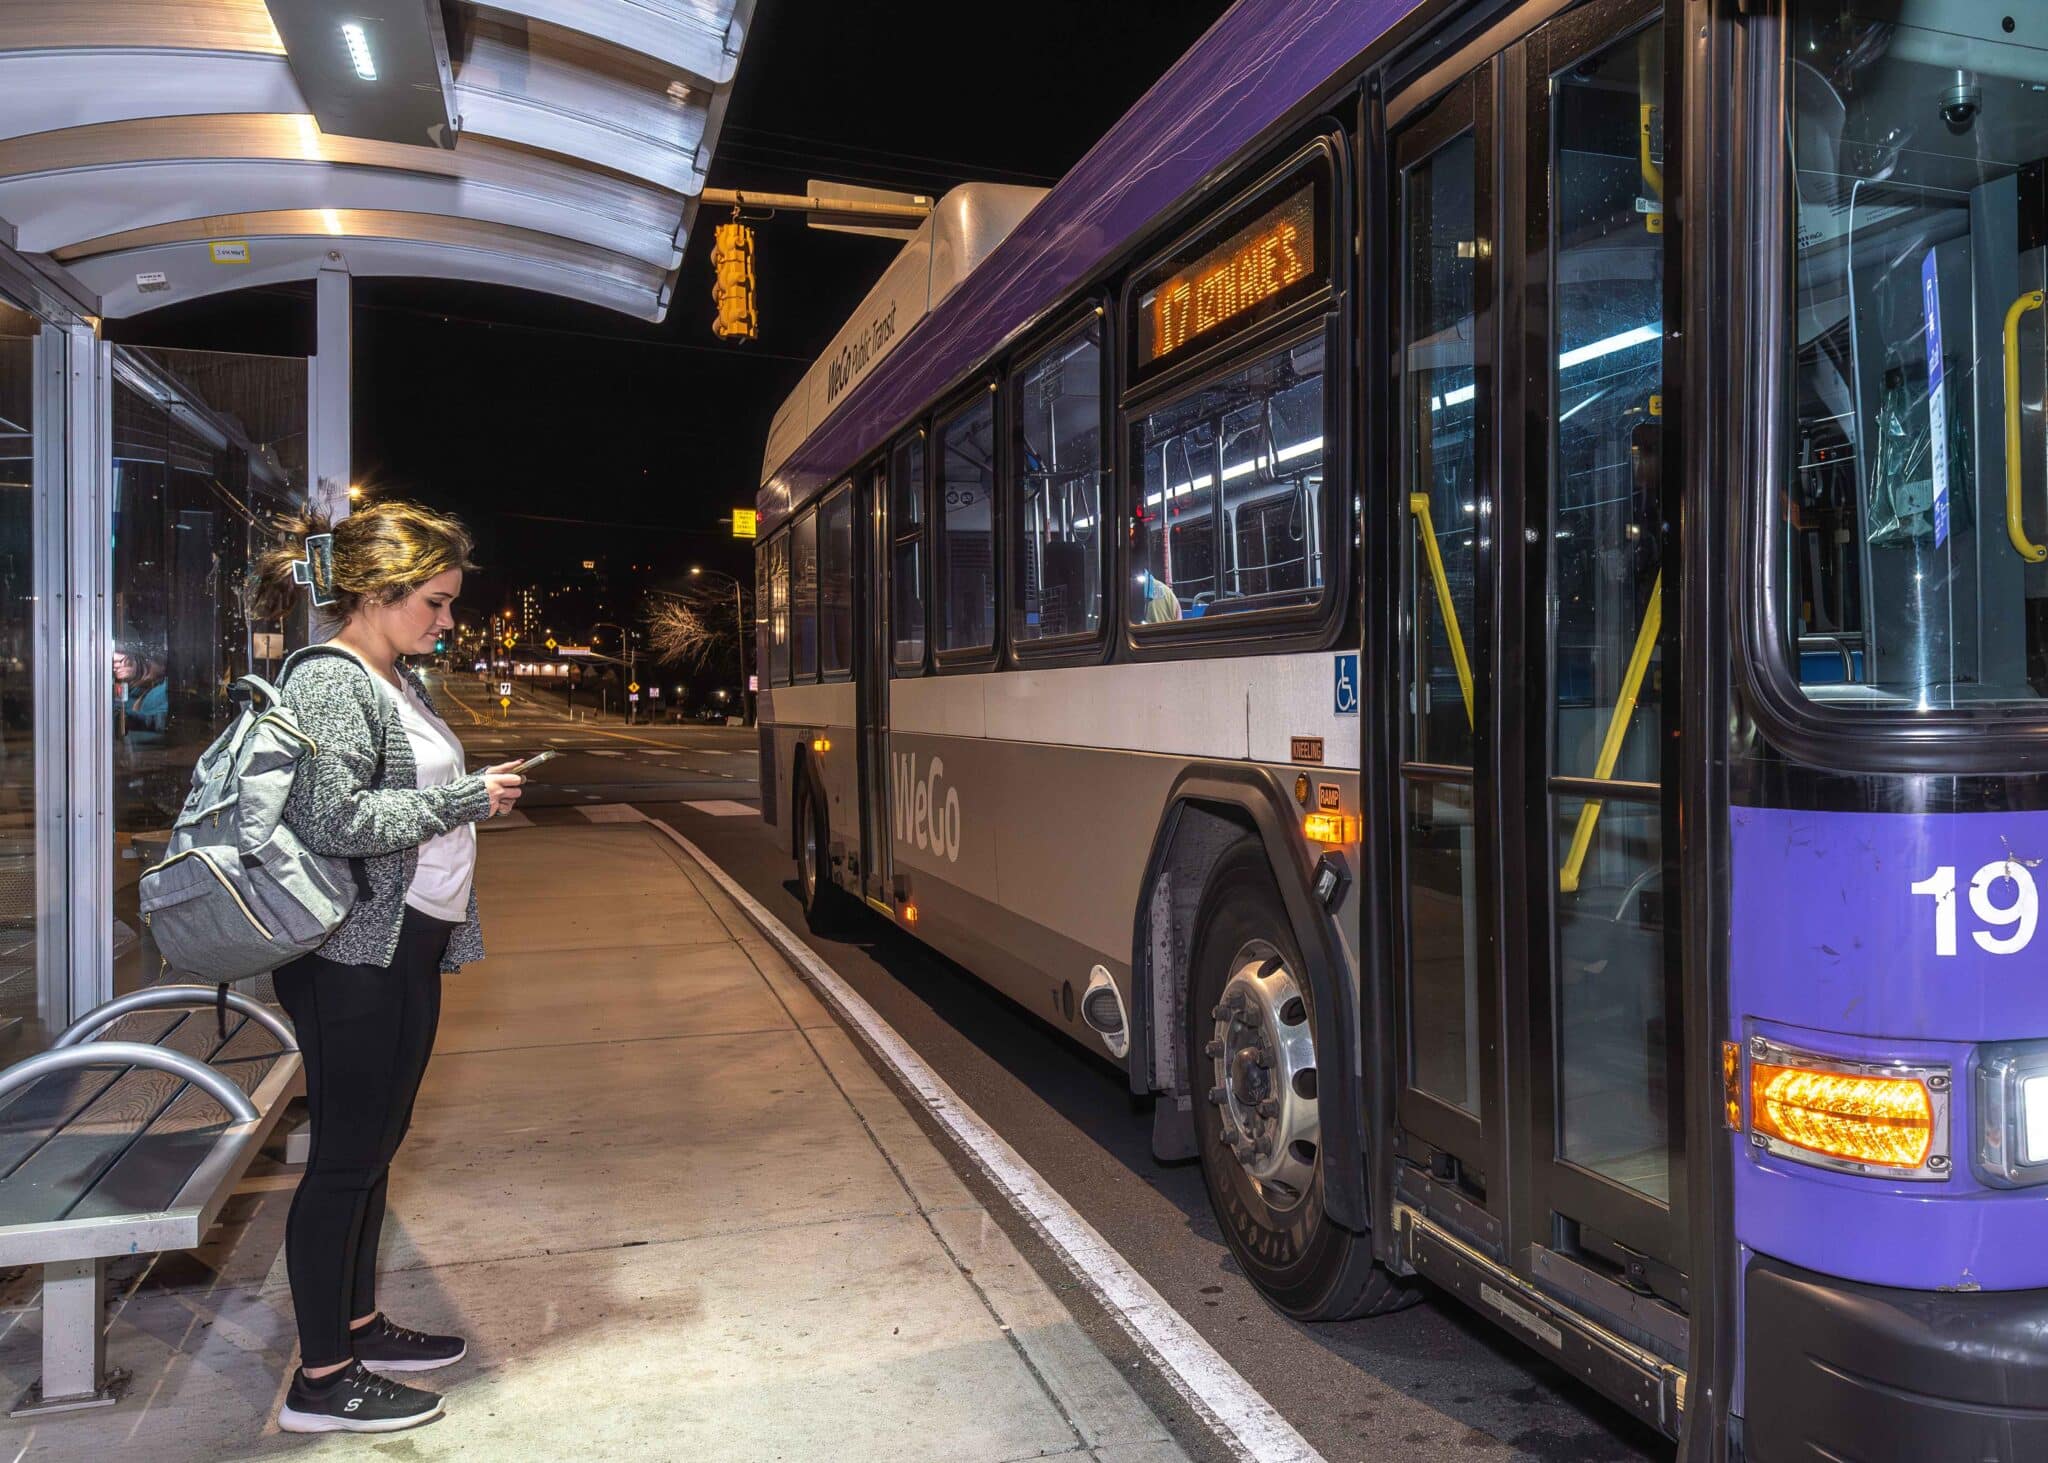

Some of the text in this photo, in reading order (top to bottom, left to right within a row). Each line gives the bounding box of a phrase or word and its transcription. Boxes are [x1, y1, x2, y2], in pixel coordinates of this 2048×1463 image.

[1162, 226, 1303, 355] 17 12TH AVE S
[827, 298, 897, 403] WeGo Public Transit
[1293, 742, 1321, 759] KNEELING
[1320, 789, 1339, 805] RAMP
[892, 751, 961, 863] WeGo
[1911, 861, 2039, 956] 19
[344, 1398, 363, 1412] S
